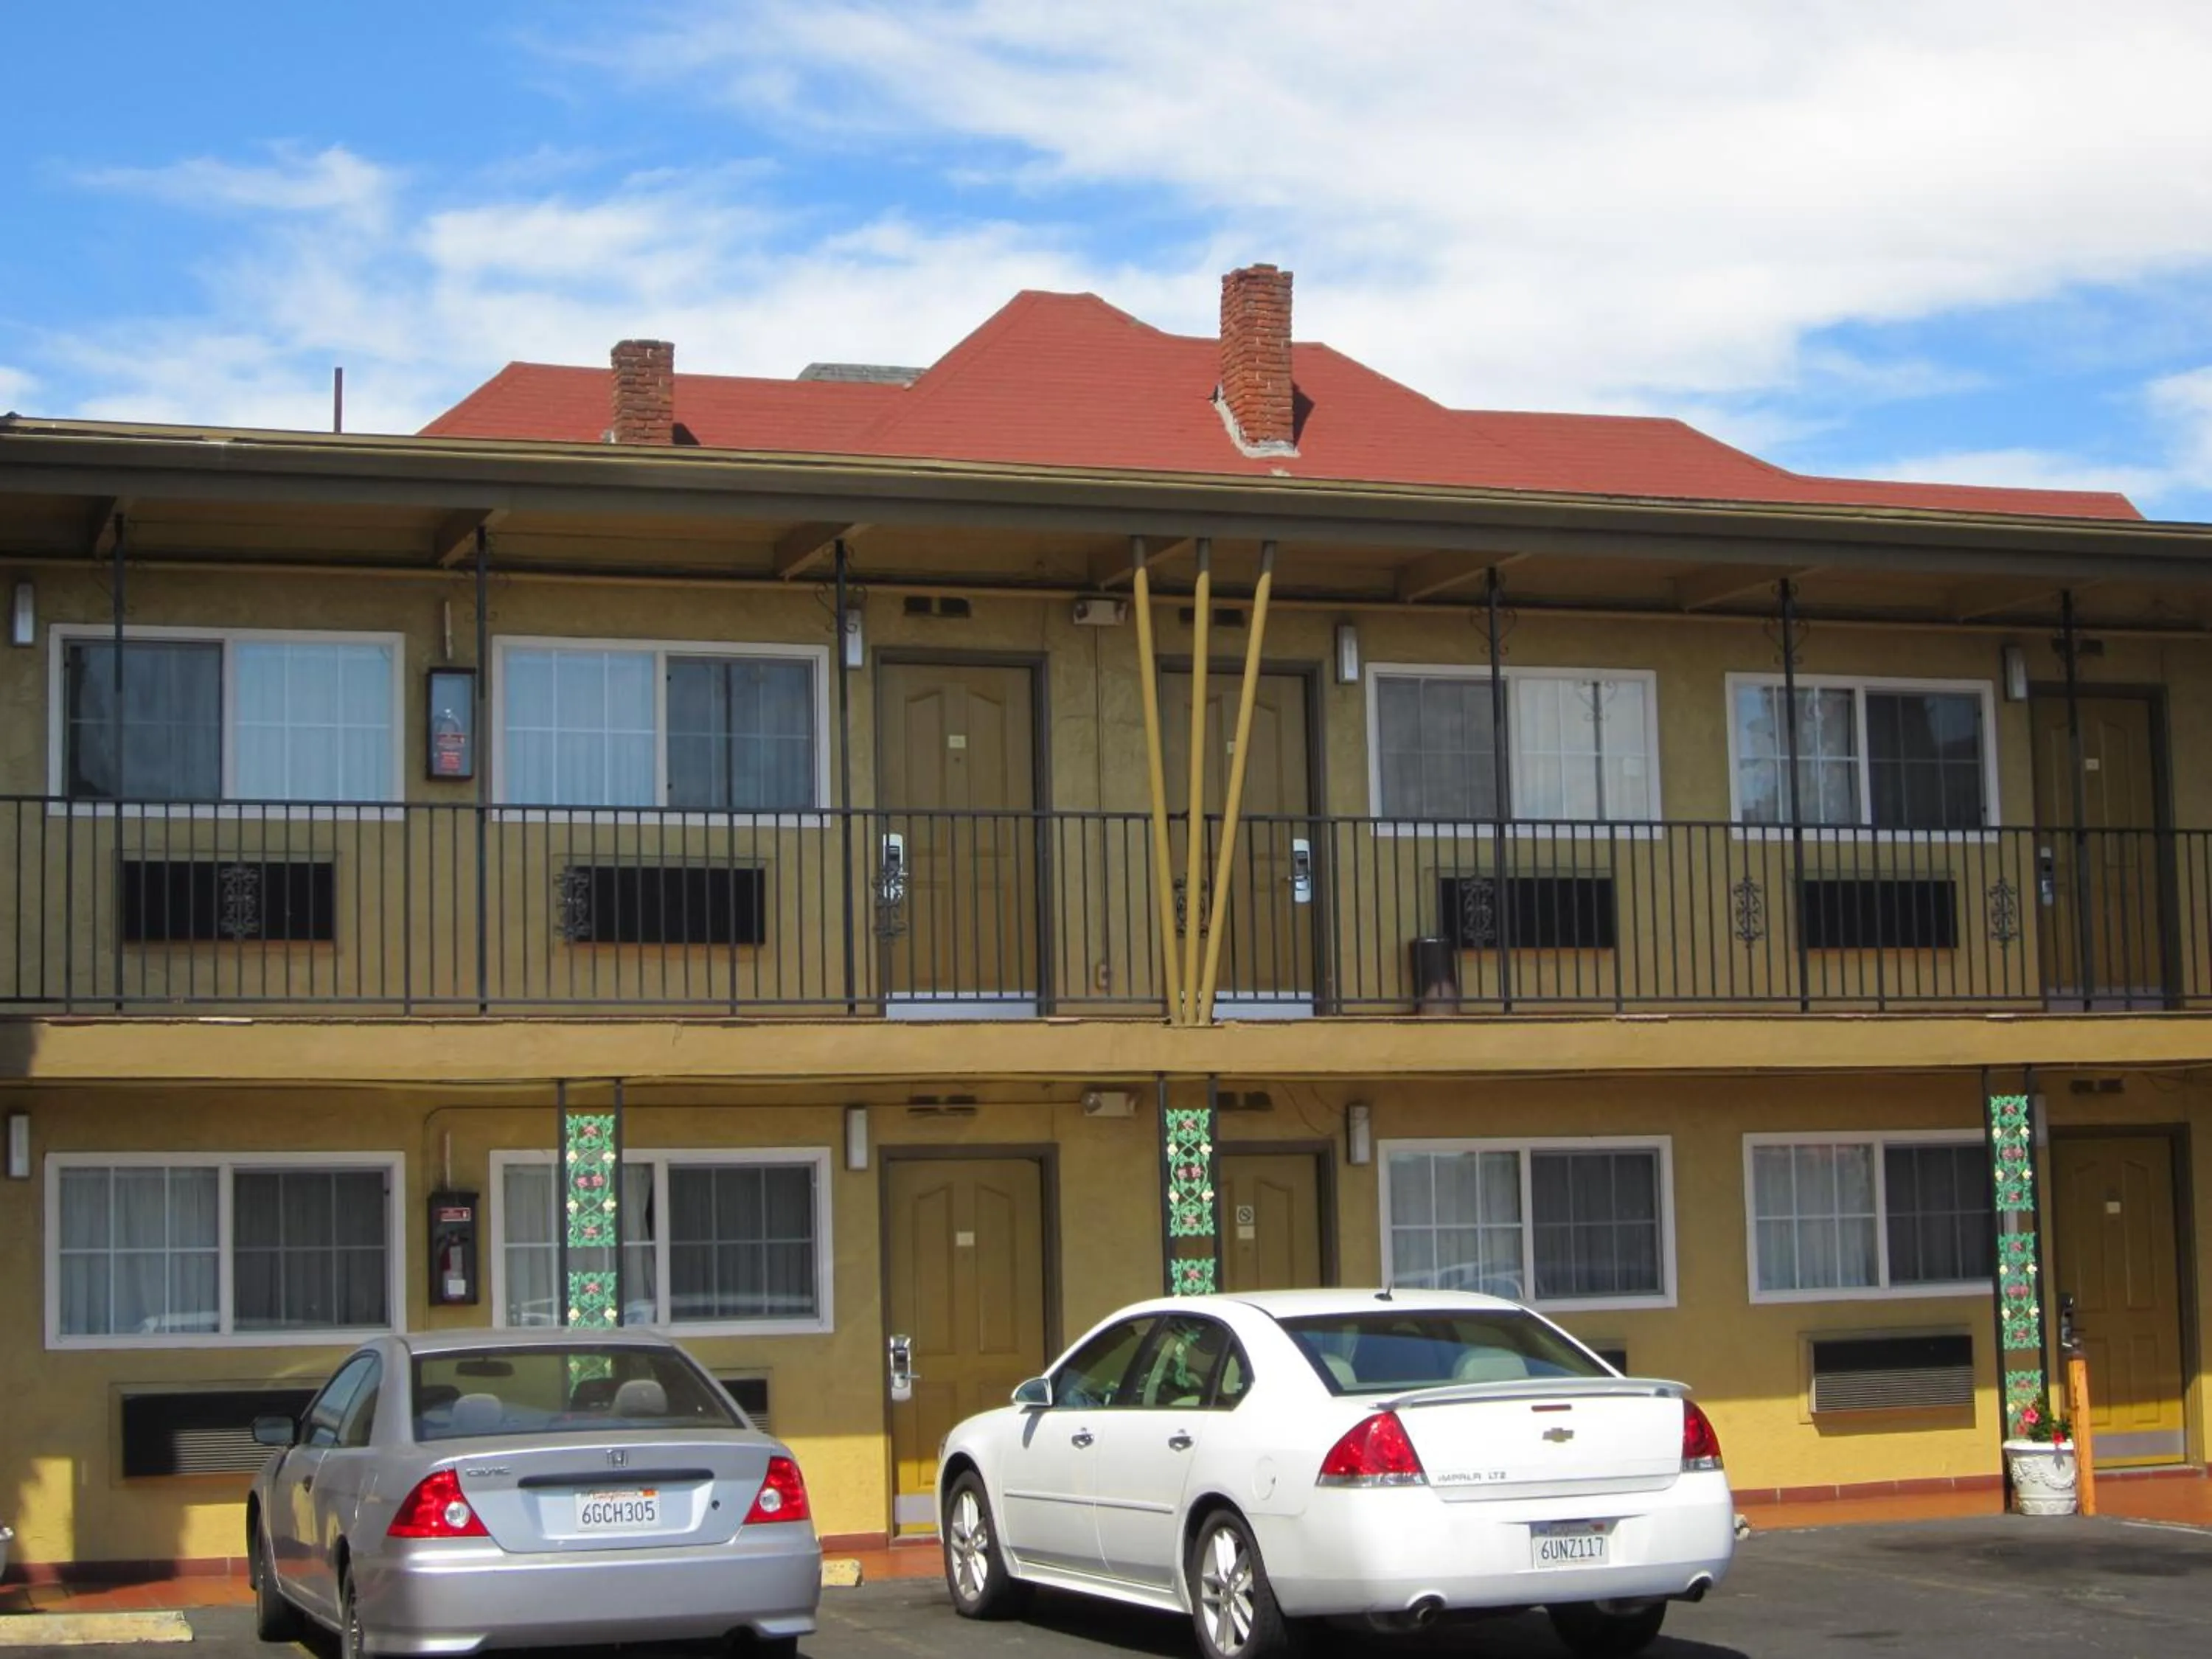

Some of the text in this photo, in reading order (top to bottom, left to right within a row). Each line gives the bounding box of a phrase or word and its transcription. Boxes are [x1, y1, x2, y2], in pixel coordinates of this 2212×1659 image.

[1437, 1472, 1481, 1482] IMPALA
[582, 1500, 655, 1524] 6GCH305
[1541, 1537, 1604, 1559] 6UNZ117
